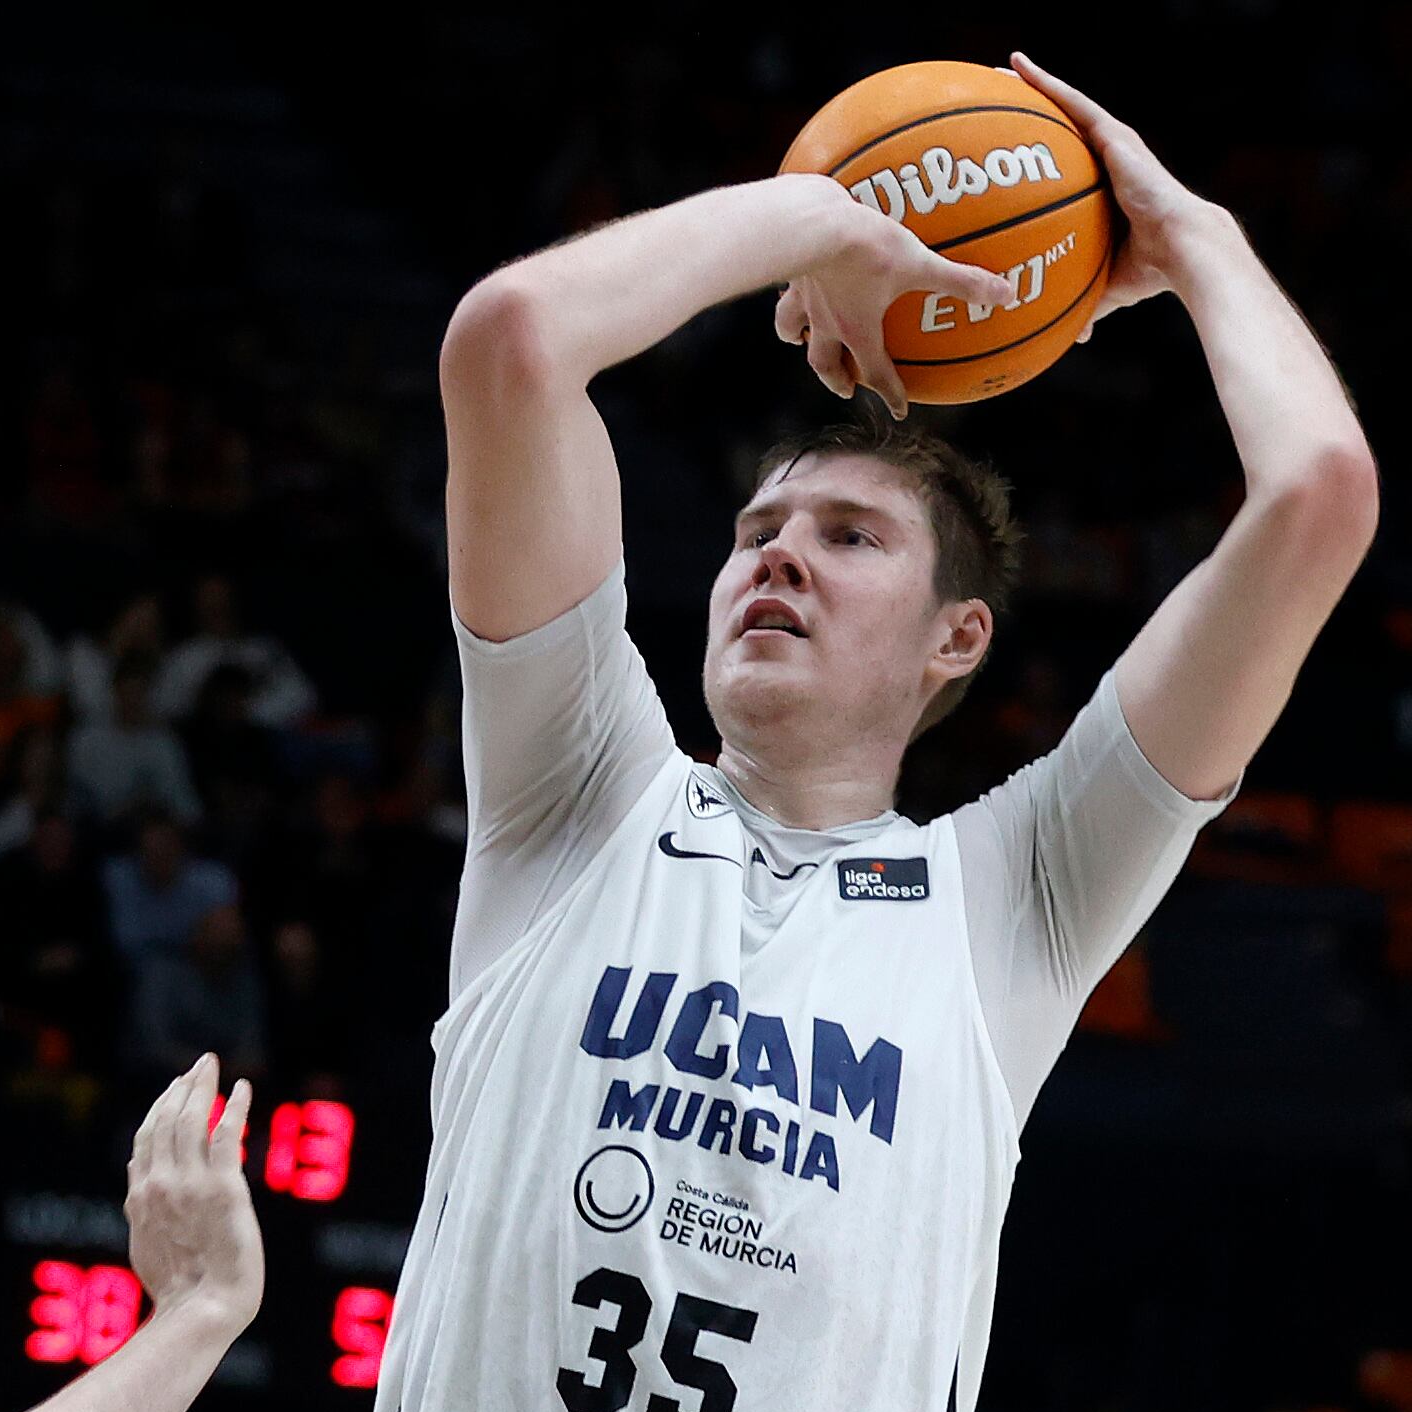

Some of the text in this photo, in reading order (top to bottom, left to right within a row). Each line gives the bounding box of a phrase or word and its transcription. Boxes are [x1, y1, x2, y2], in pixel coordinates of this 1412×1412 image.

[850, 142, 1063, 224] Wilson
[844, 868, 882, 886] liga
[845, 880, 926, 899] endesa
[580, 964, 903, 1147] UCAM
[597, 1078, 840, 1194] MURCIA
[659, 1220, 798, 1275] DE MURCIA
